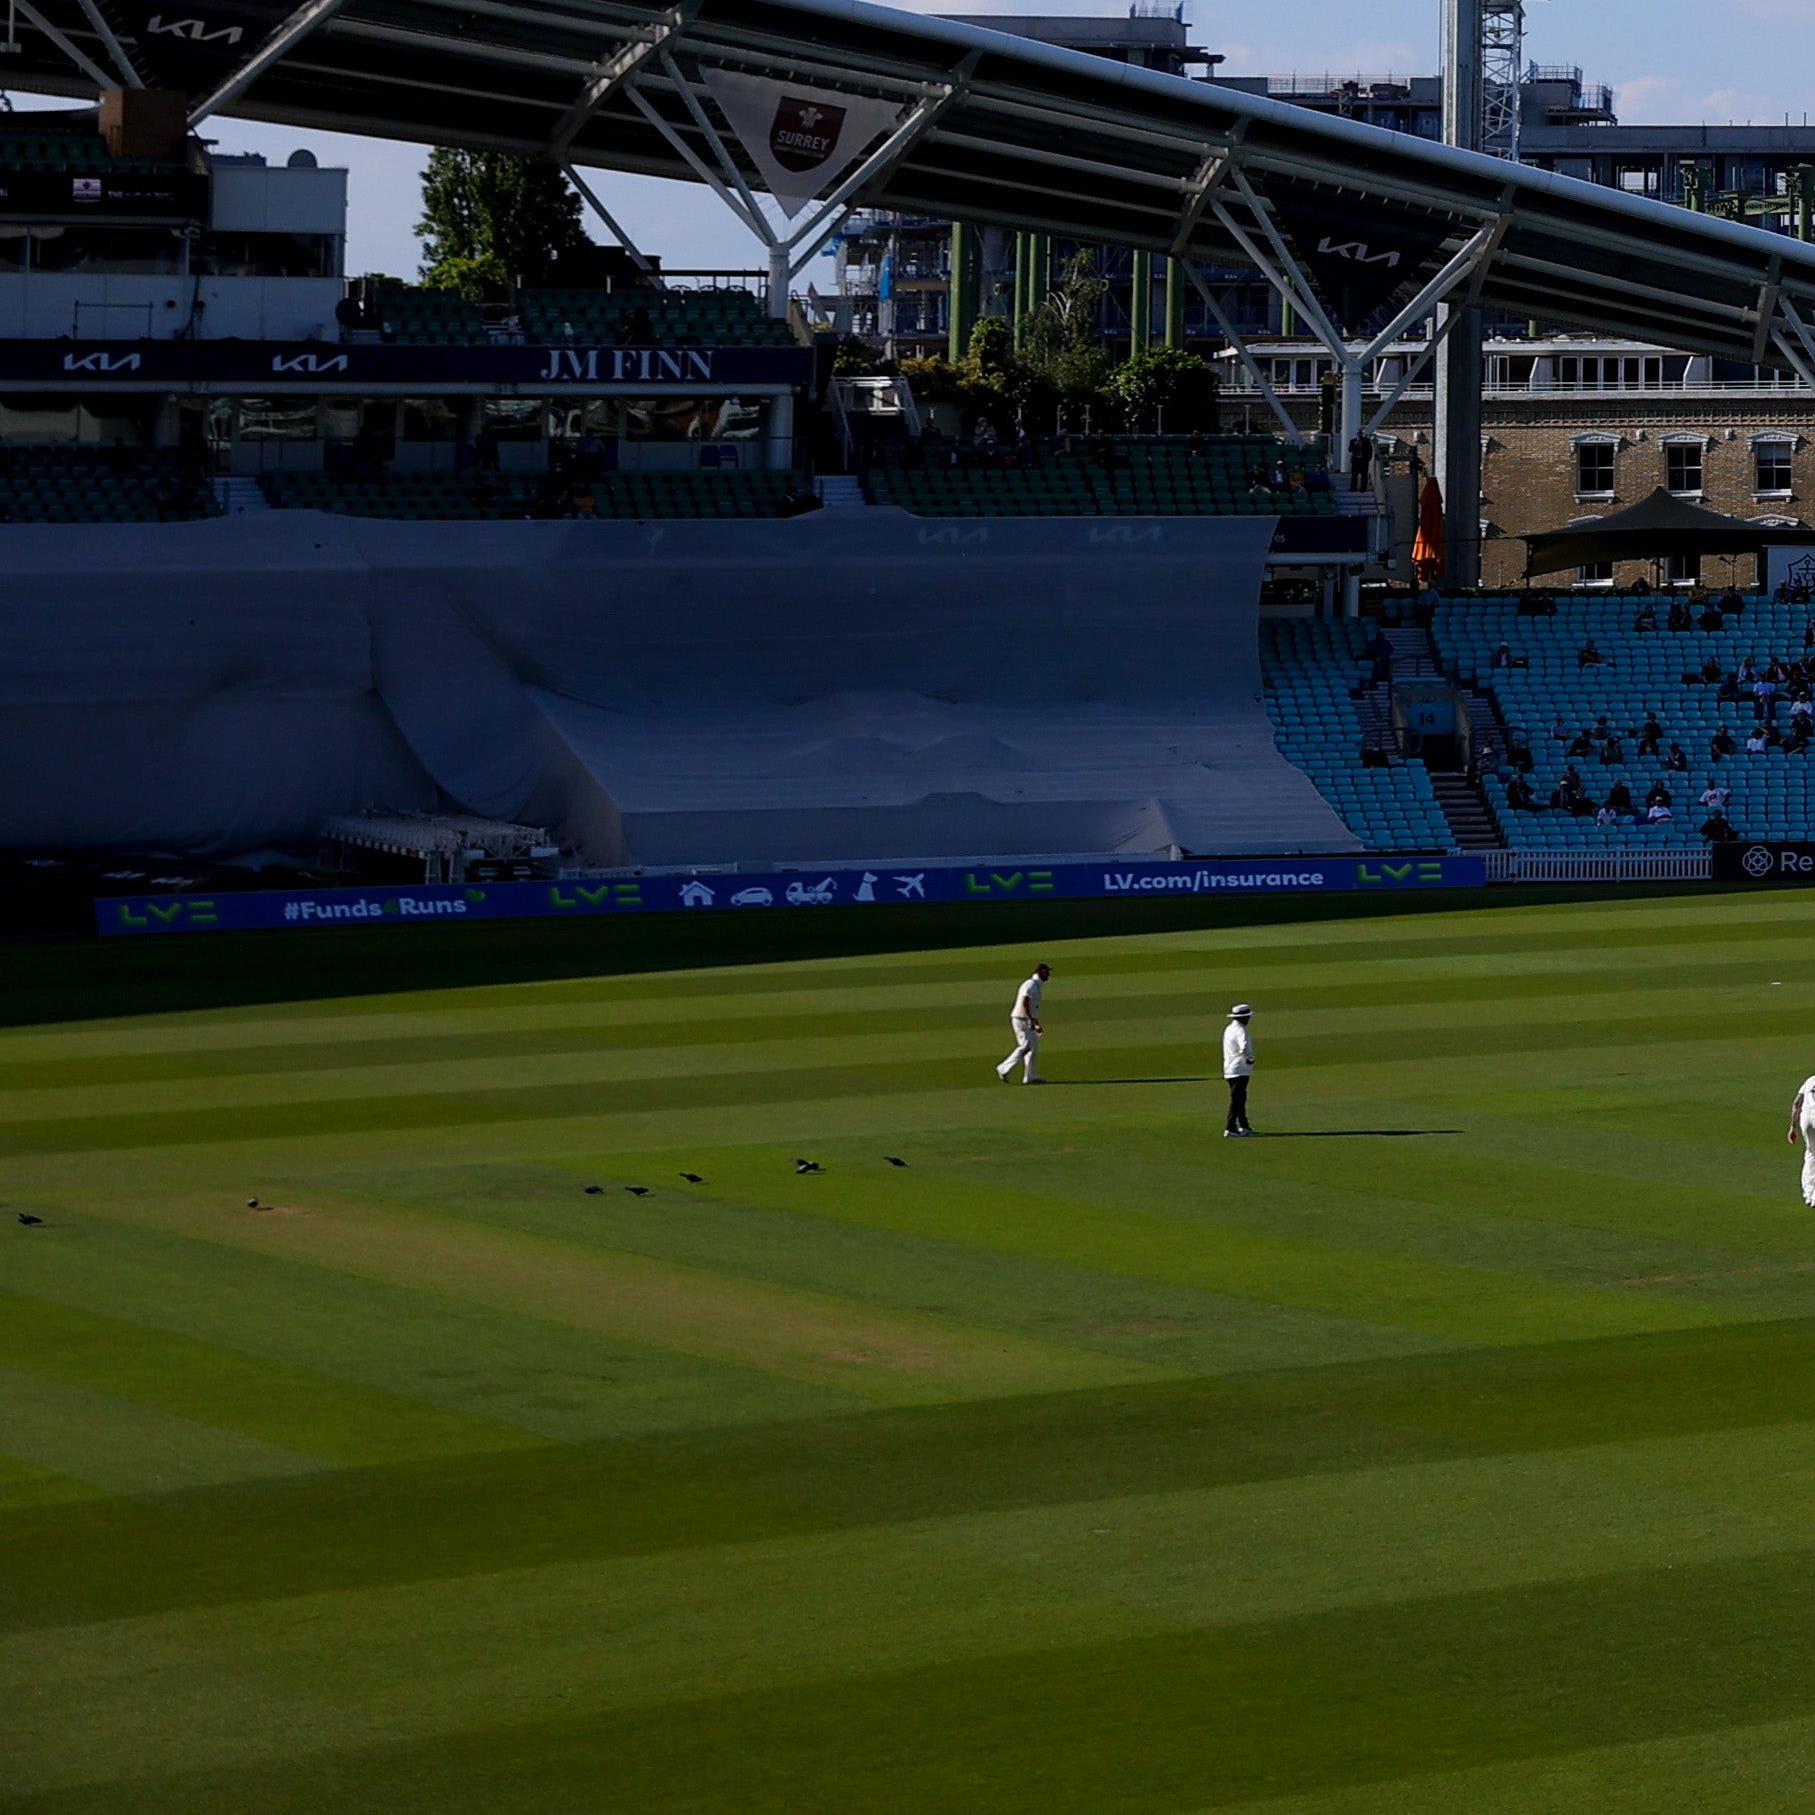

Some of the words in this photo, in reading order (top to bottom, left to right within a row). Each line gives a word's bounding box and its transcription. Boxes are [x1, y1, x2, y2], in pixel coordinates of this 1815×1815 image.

[777, 130, 830, 151] SURREY
[539, 349, 600, 380] JM
[612, 349, 716, 381] FINN
[1419, 712, 1436, 725] 14
[1102, 869, 1325, 893] LV.com/insurance
[283, 896, 468, 922] #Funds4Runs
